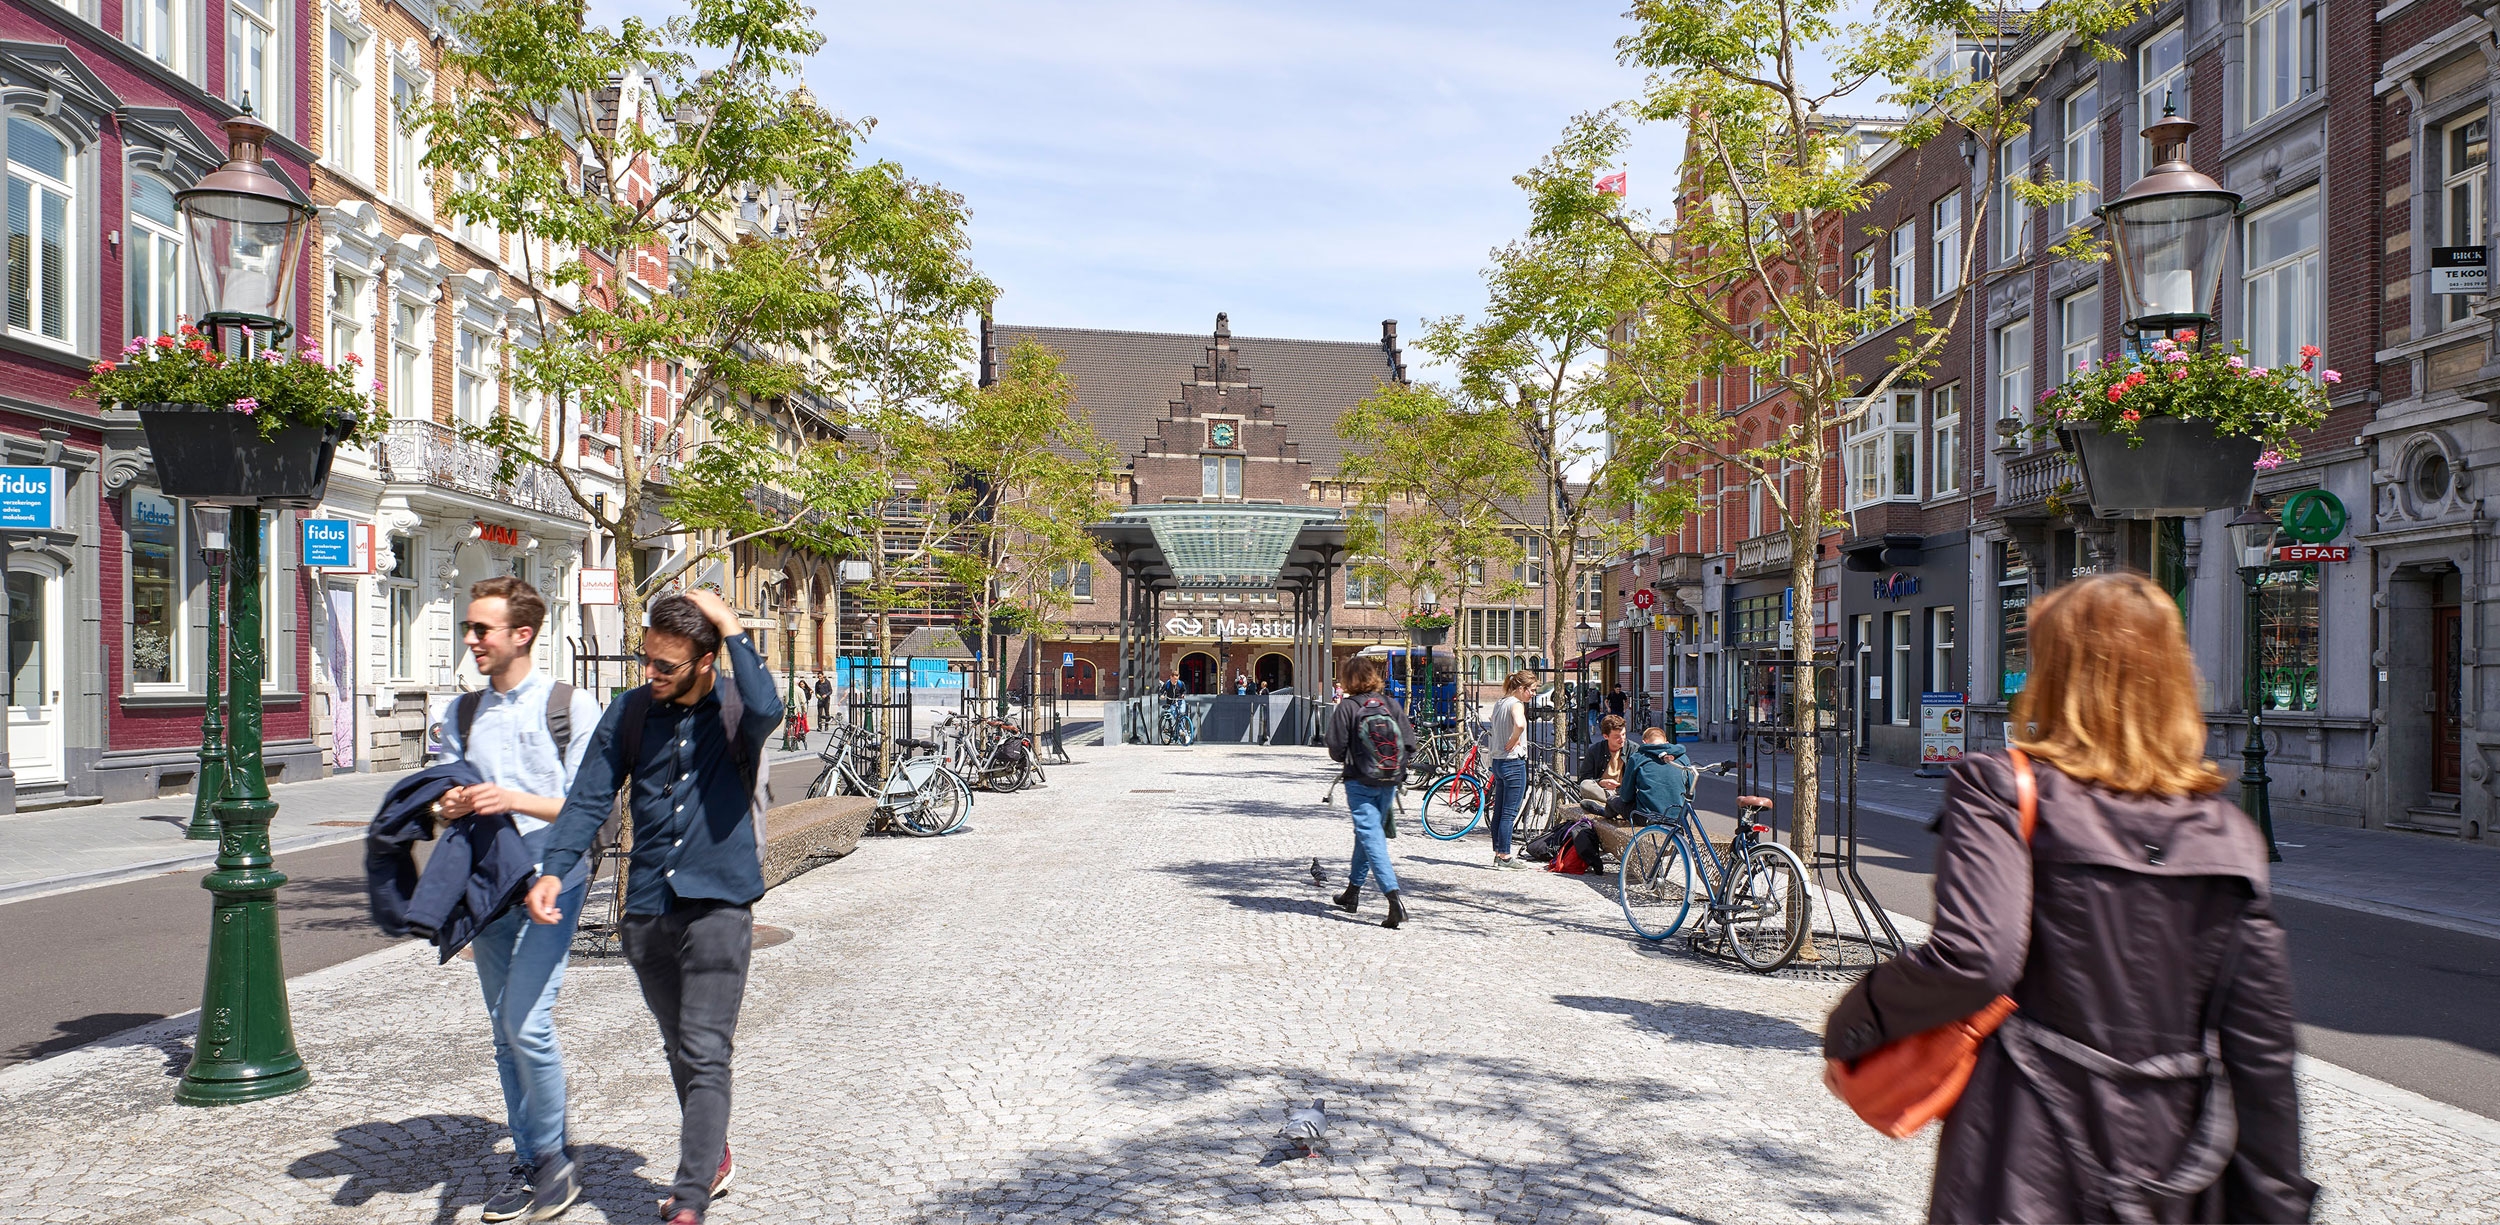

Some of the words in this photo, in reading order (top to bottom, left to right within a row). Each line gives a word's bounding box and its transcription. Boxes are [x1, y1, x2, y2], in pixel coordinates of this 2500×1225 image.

[2452, 251, 2482, 260] BRCK
[2445, 270, 2459, 278] TE
[0, 474, 47, 494] fidus
[138, 502, 170, 525] fidus
[308, 525, 345, 540] fidus
[2290, 548, 2346, 559] SPAR
[2257, 570, 2299, 585] SPAR
[2003, 598, 2027, 609] SPAR
[1217, 618, 1325, 637] Maastrih
